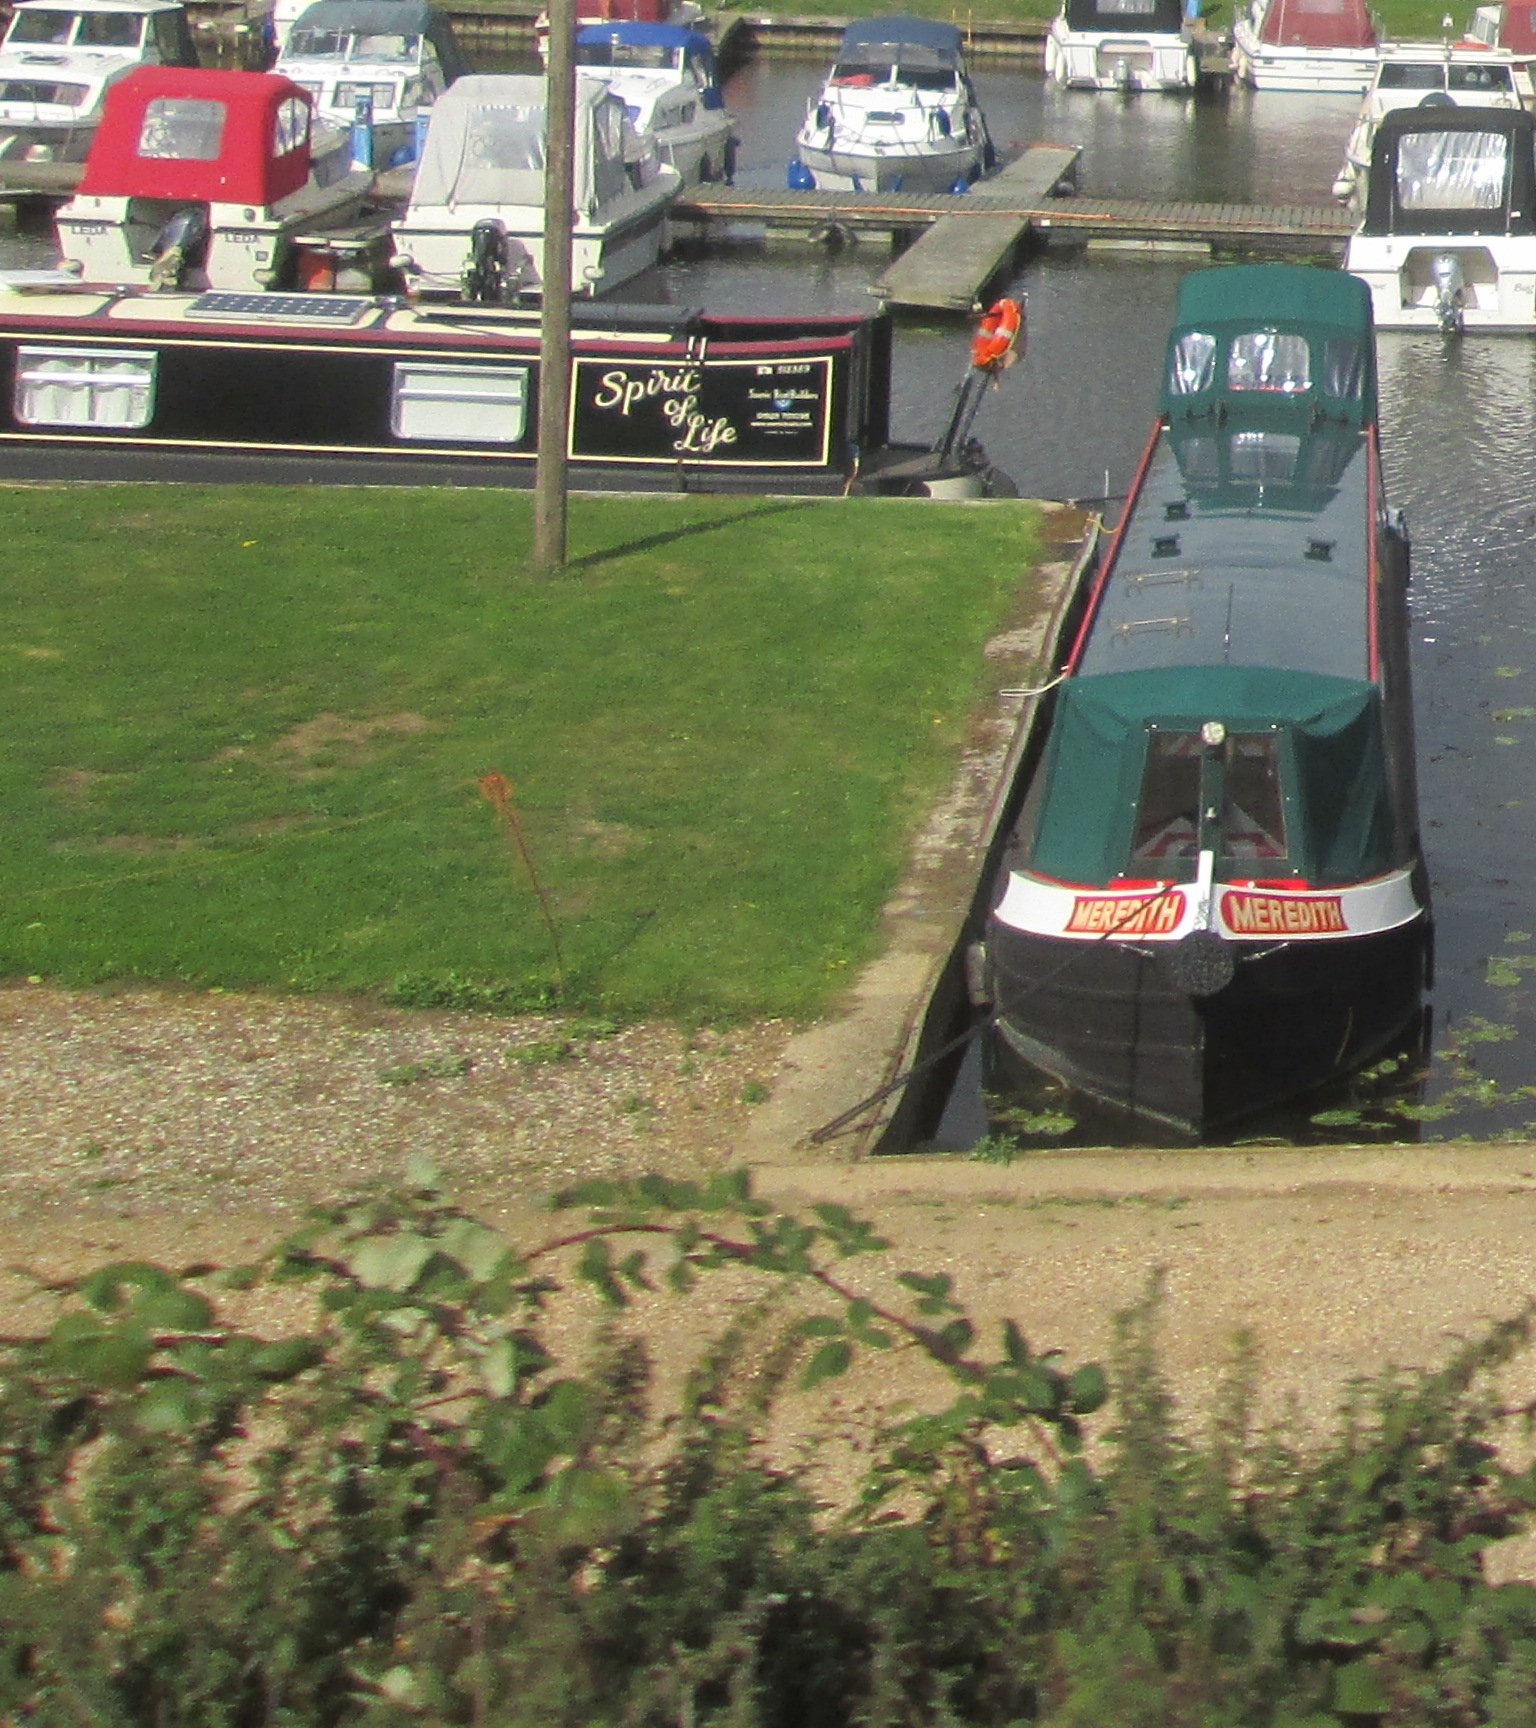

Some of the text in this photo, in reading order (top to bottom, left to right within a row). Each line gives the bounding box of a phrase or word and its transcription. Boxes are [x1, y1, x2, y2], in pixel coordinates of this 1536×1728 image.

[594, 368, 702, 416] Spirit
[663, 395, 698, 427] of
[673, 412, 738, 452] Life
[1073, 896, 1181, 932] MEREDITH
[1228, 895, 1341, 932] MEREDITH
